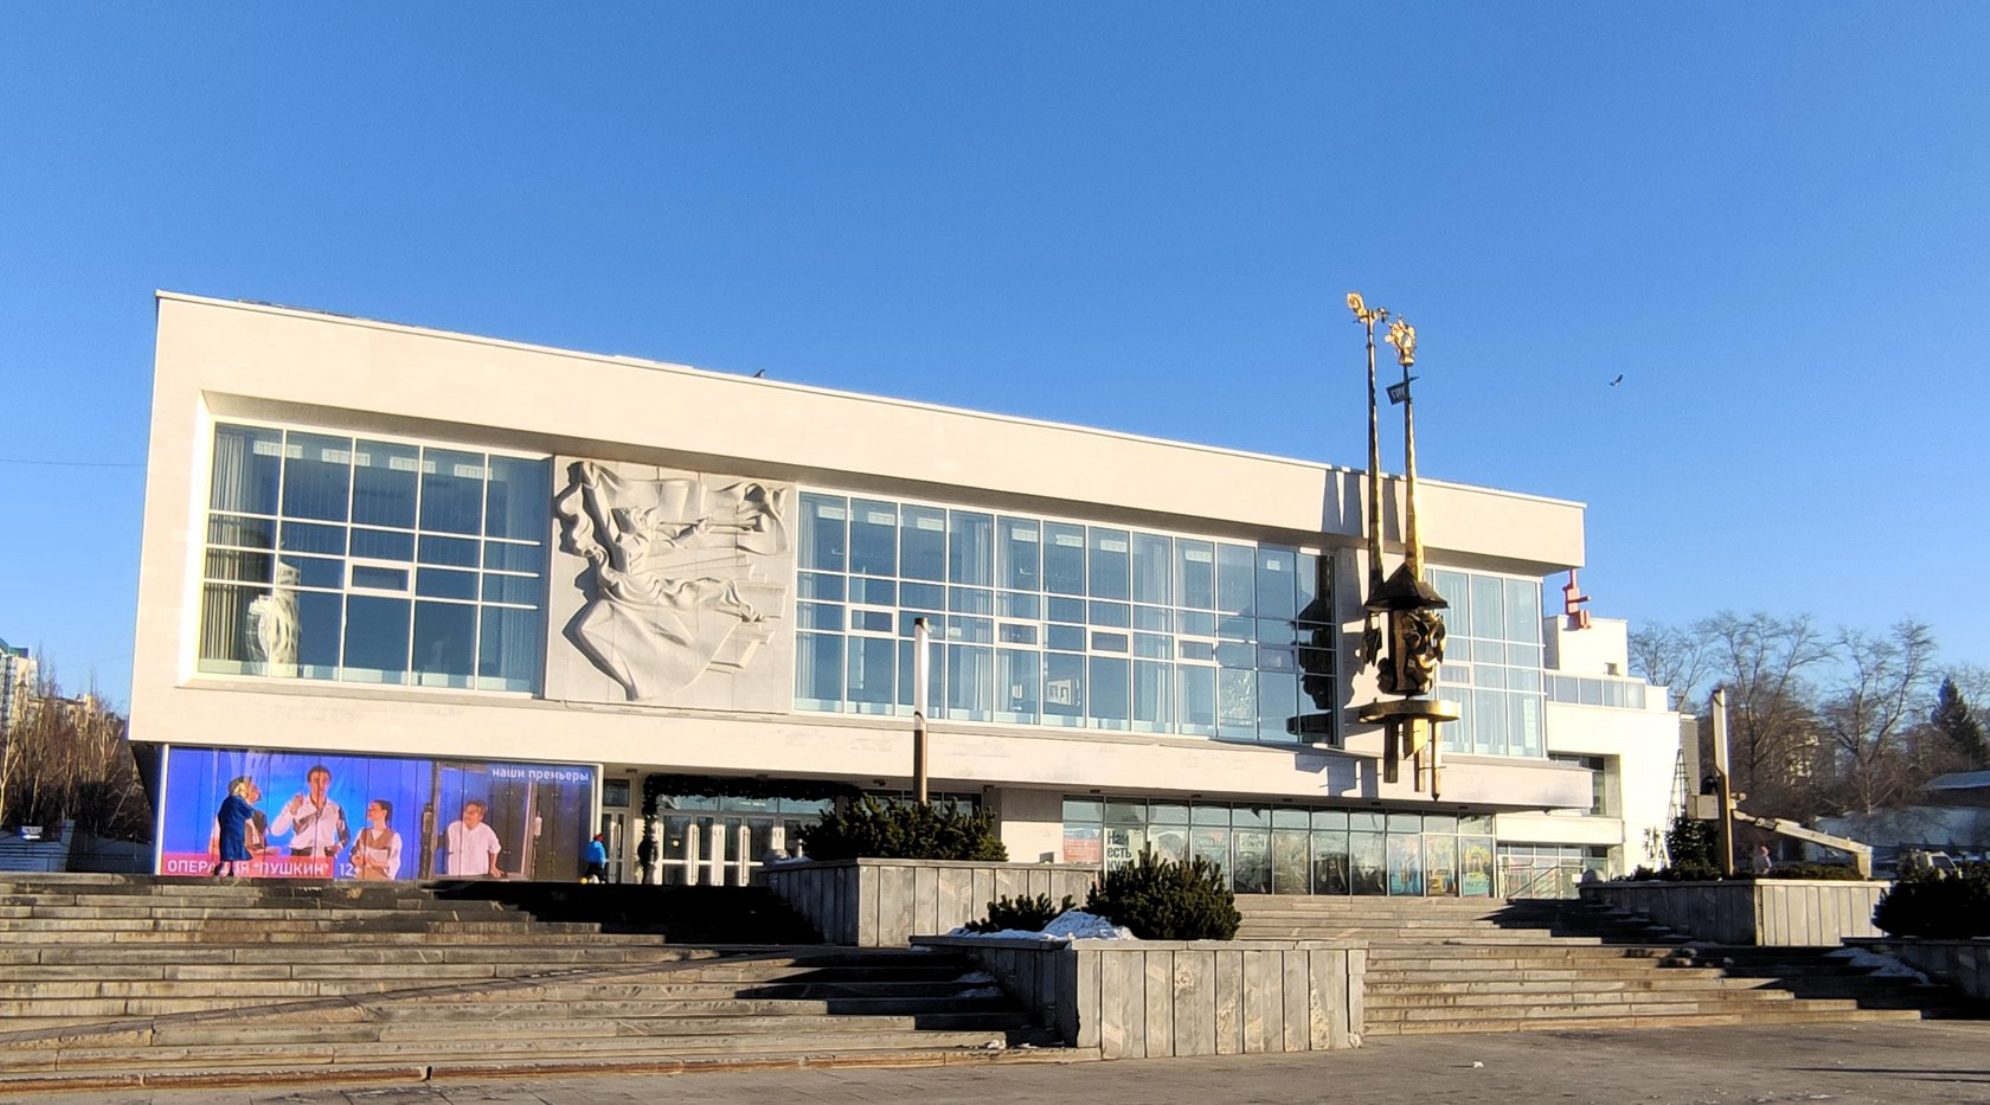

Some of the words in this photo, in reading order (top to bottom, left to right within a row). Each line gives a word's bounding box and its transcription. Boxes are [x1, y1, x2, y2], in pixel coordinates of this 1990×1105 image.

[492, 768, 525, 778] наши
[528, 768, 589, 783] премьеры
[1107, 847, 1132, 858] есть
[167, 859, 249, 874] ОПЕРАИЯ
